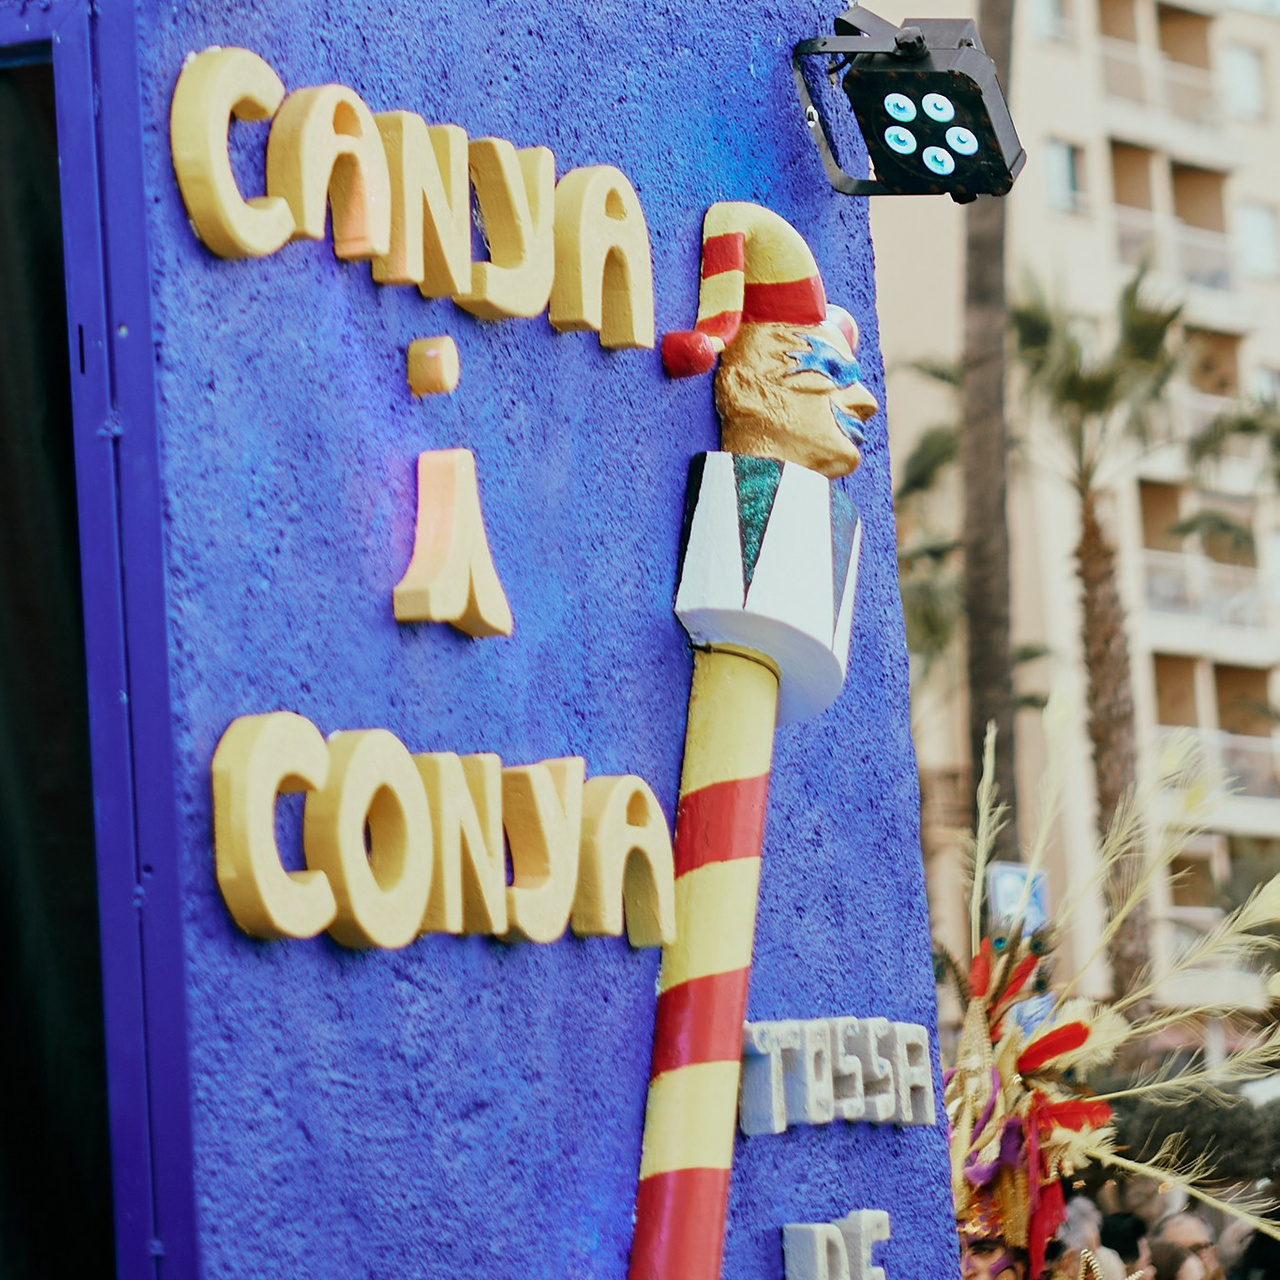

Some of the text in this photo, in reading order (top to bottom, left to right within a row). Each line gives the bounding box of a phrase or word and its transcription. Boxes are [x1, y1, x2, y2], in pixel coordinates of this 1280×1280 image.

[170, 46, 655, 350] CANYA
[212, 711, 676, 949] CONYA
[740, 1016, 936, 1135] TOSSA
[783, 1209, 891, 1280] DE
